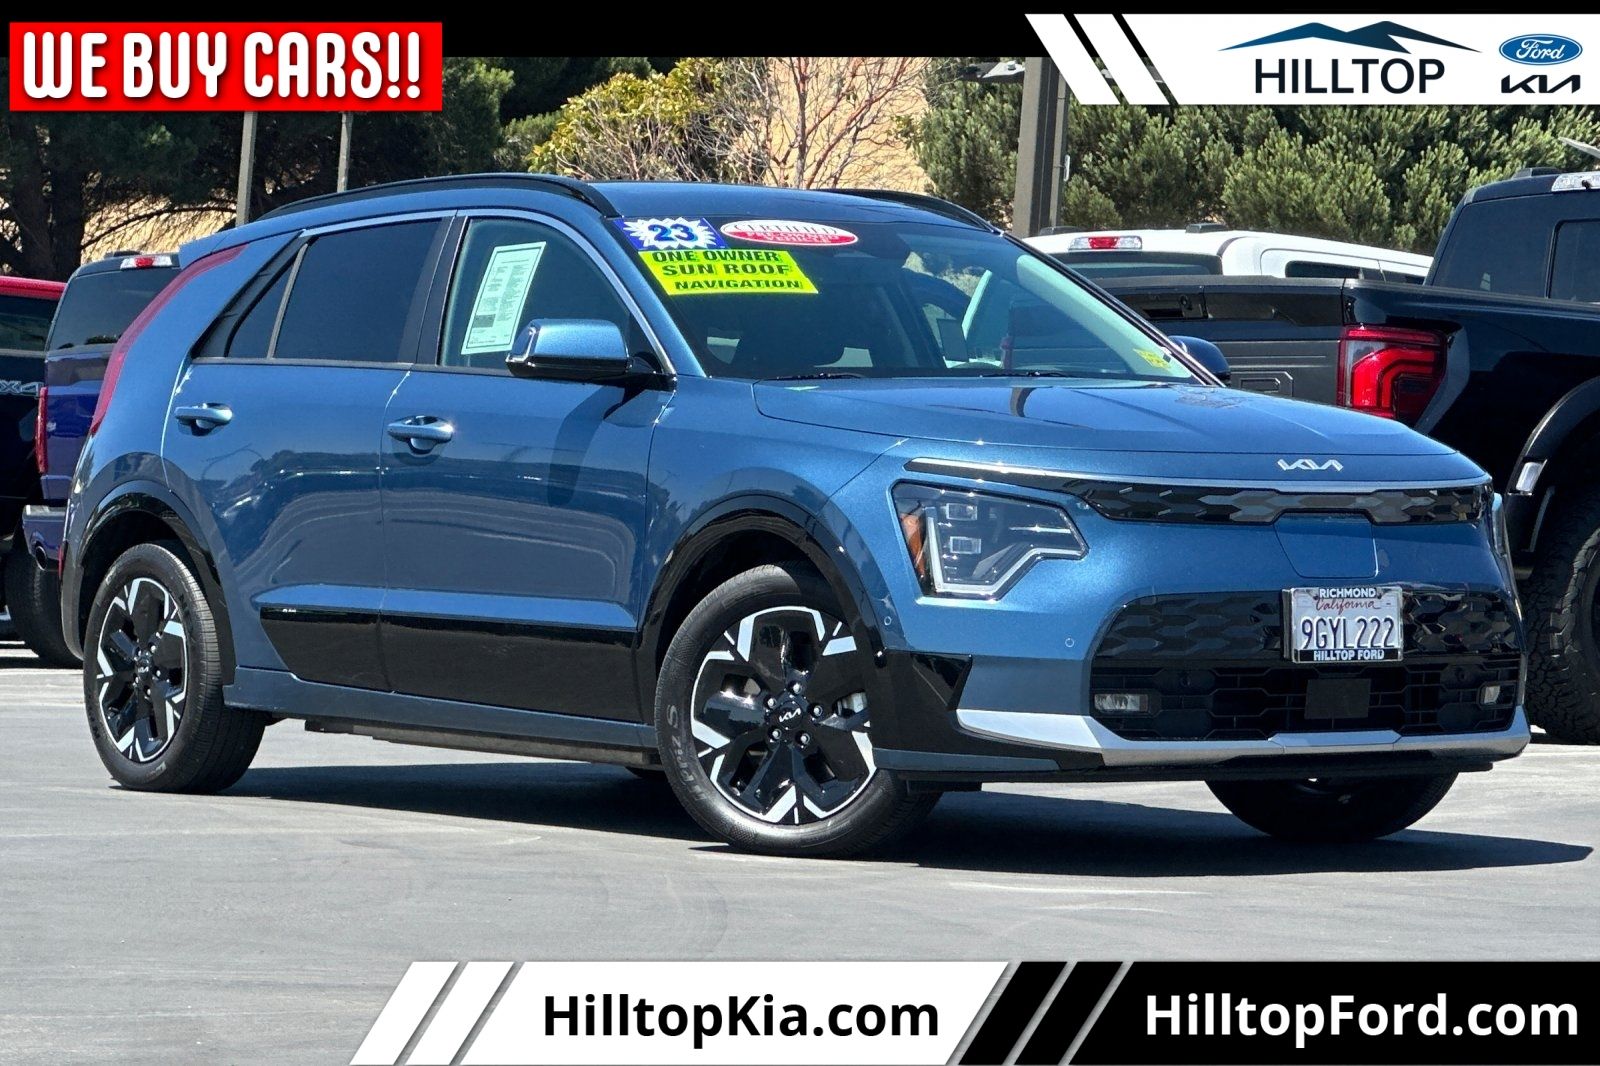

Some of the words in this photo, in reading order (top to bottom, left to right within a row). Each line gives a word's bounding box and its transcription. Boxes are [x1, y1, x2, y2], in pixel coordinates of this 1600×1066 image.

[647, 223, 699, 242] 23
[652, 250, 699, 263] ONE
[703, 250, 780, 262] OWNER
[661, 263, 716, 277] SUN
[723, 263, 792, 275] ROOF
[674, 279, 803, 290] NAVIGATION
[1277, 459, 1344, 471] KIA
[1319, 588, 1377, 598] RICHMOND
[1315, 599, 1381, 615] California
[1301, 617, 1395, 649] 9GYL222
[1313, 650, 1355, 661] HILLTOP
[1357, 649, 1385, 660] FORD
